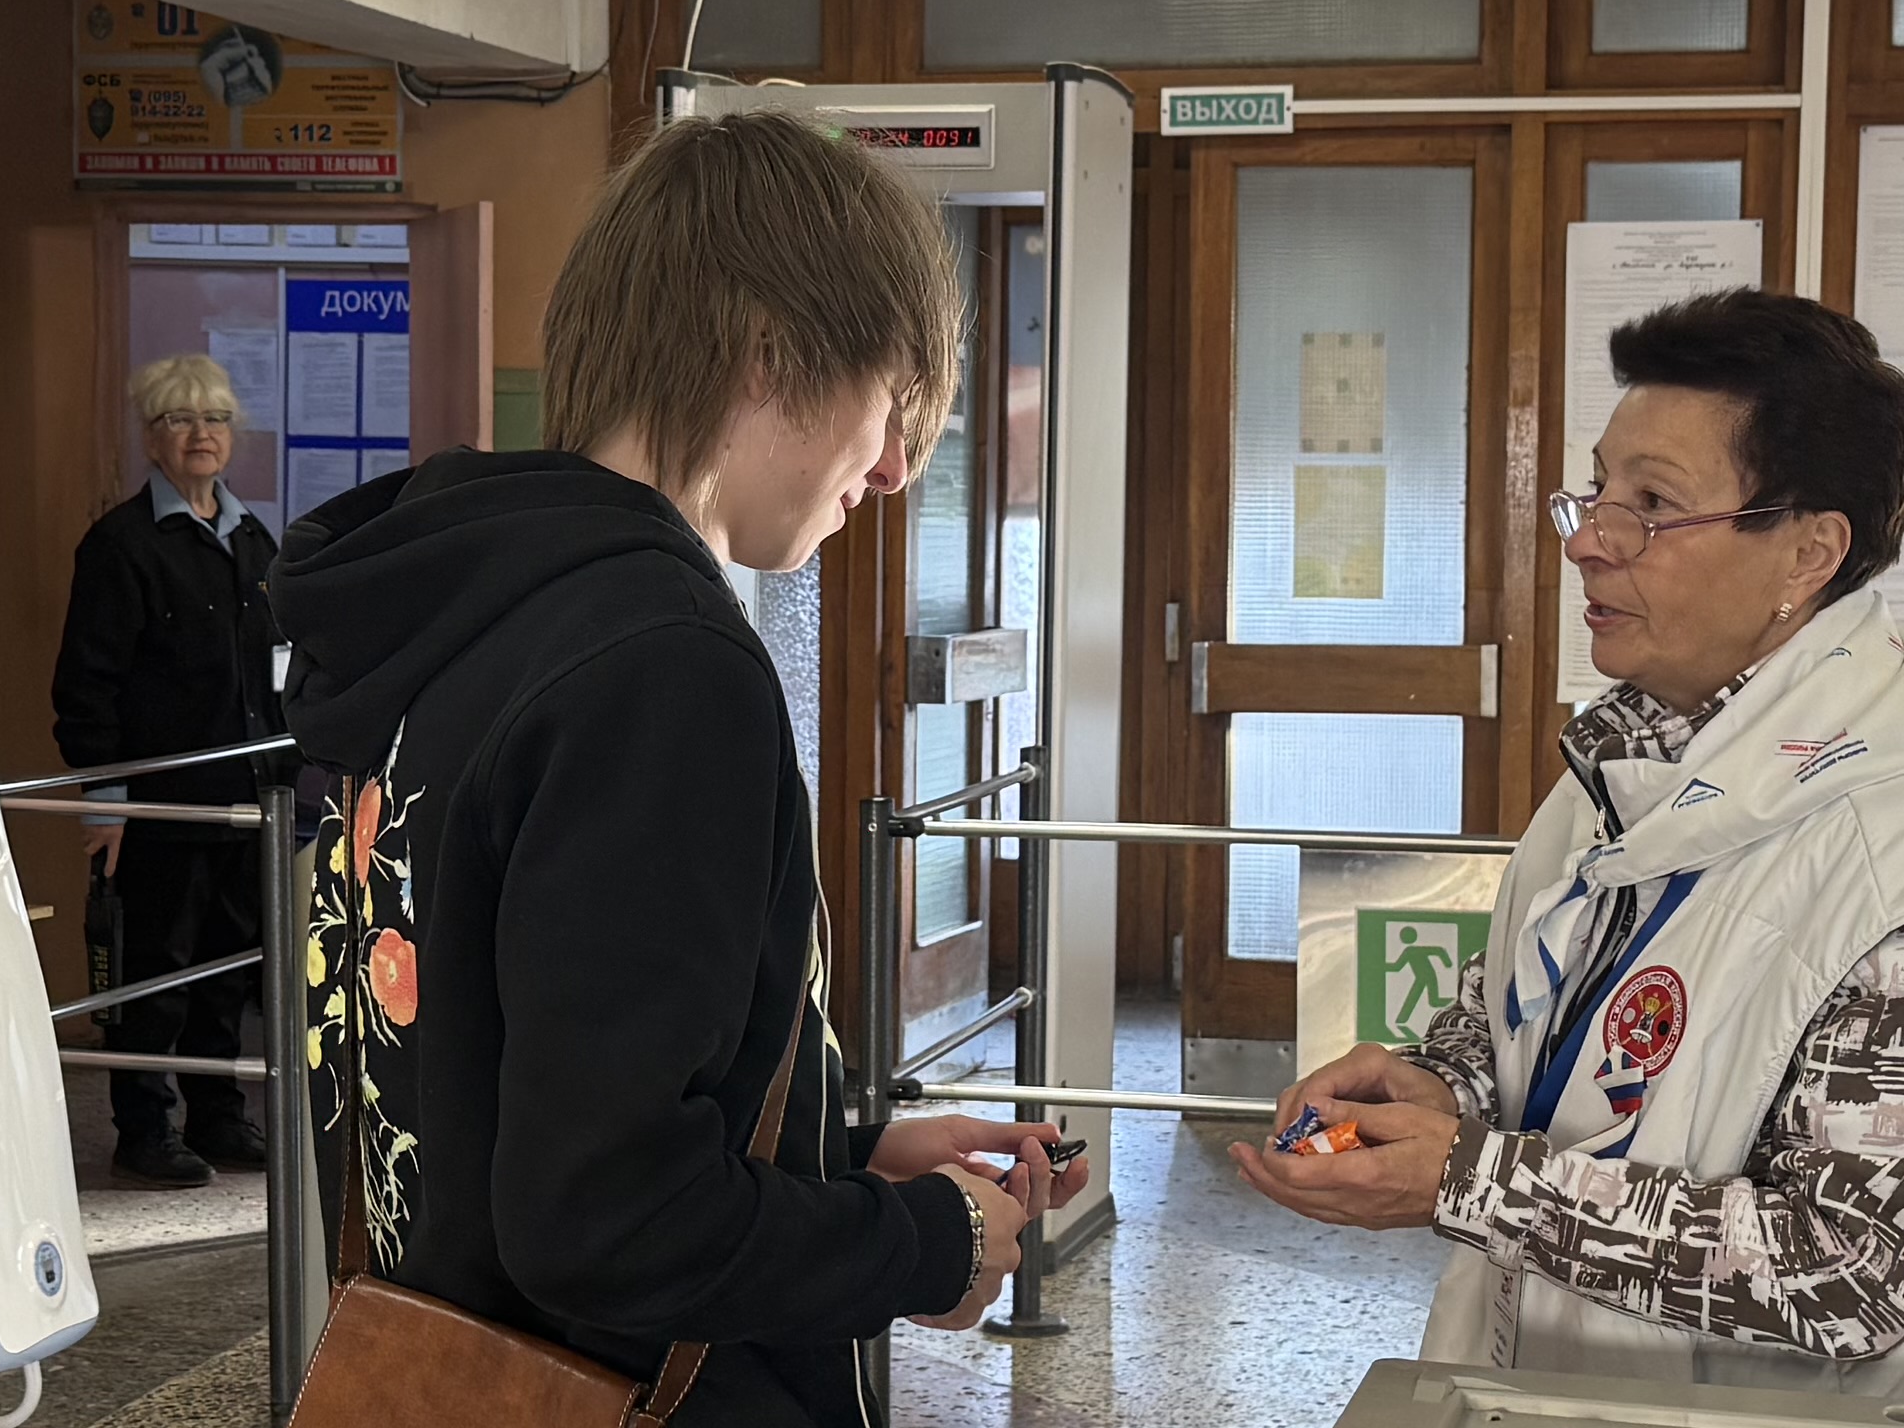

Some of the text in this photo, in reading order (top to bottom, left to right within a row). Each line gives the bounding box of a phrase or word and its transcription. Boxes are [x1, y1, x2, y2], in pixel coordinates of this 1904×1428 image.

[83, 74, 121, 87] ФСБ
[1176, 98, 1278, 125] ВЫХОД
[289, 124, 332, 142] 112
[924, 130, 973, 146] 0091
[224, 155, 271, 171] ПАМЯТЬ
[277, 156, 316, 171] СВОЕГО
[322, 155, 379, 171] ТЕЛЕФОНА
